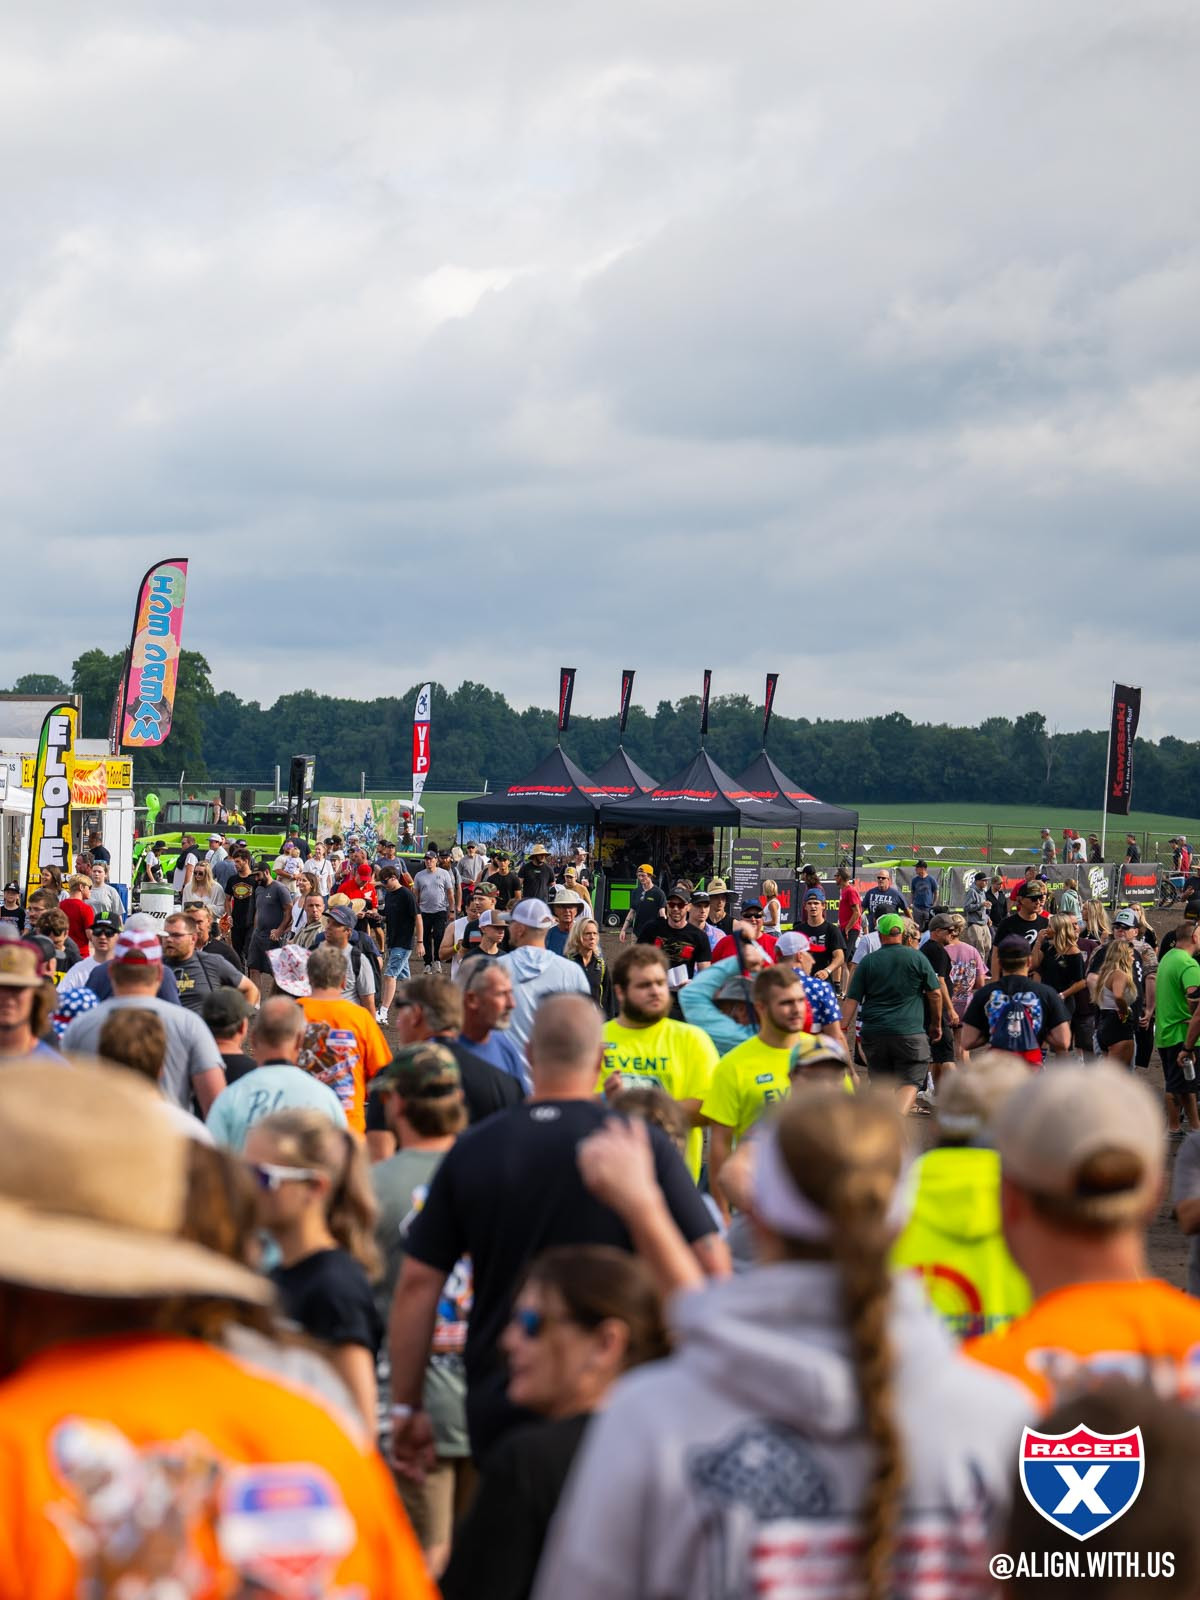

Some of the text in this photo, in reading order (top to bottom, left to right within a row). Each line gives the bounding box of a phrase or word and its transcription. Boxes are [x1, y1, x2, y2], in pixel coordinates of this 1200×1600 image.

[416, 725, 429, 772] VIP
[1112, 702, 1126, 798] Kawasaki
[37, 714, 71, 870] ELOTE
[603, 1055, 670, 1072] EVENT
